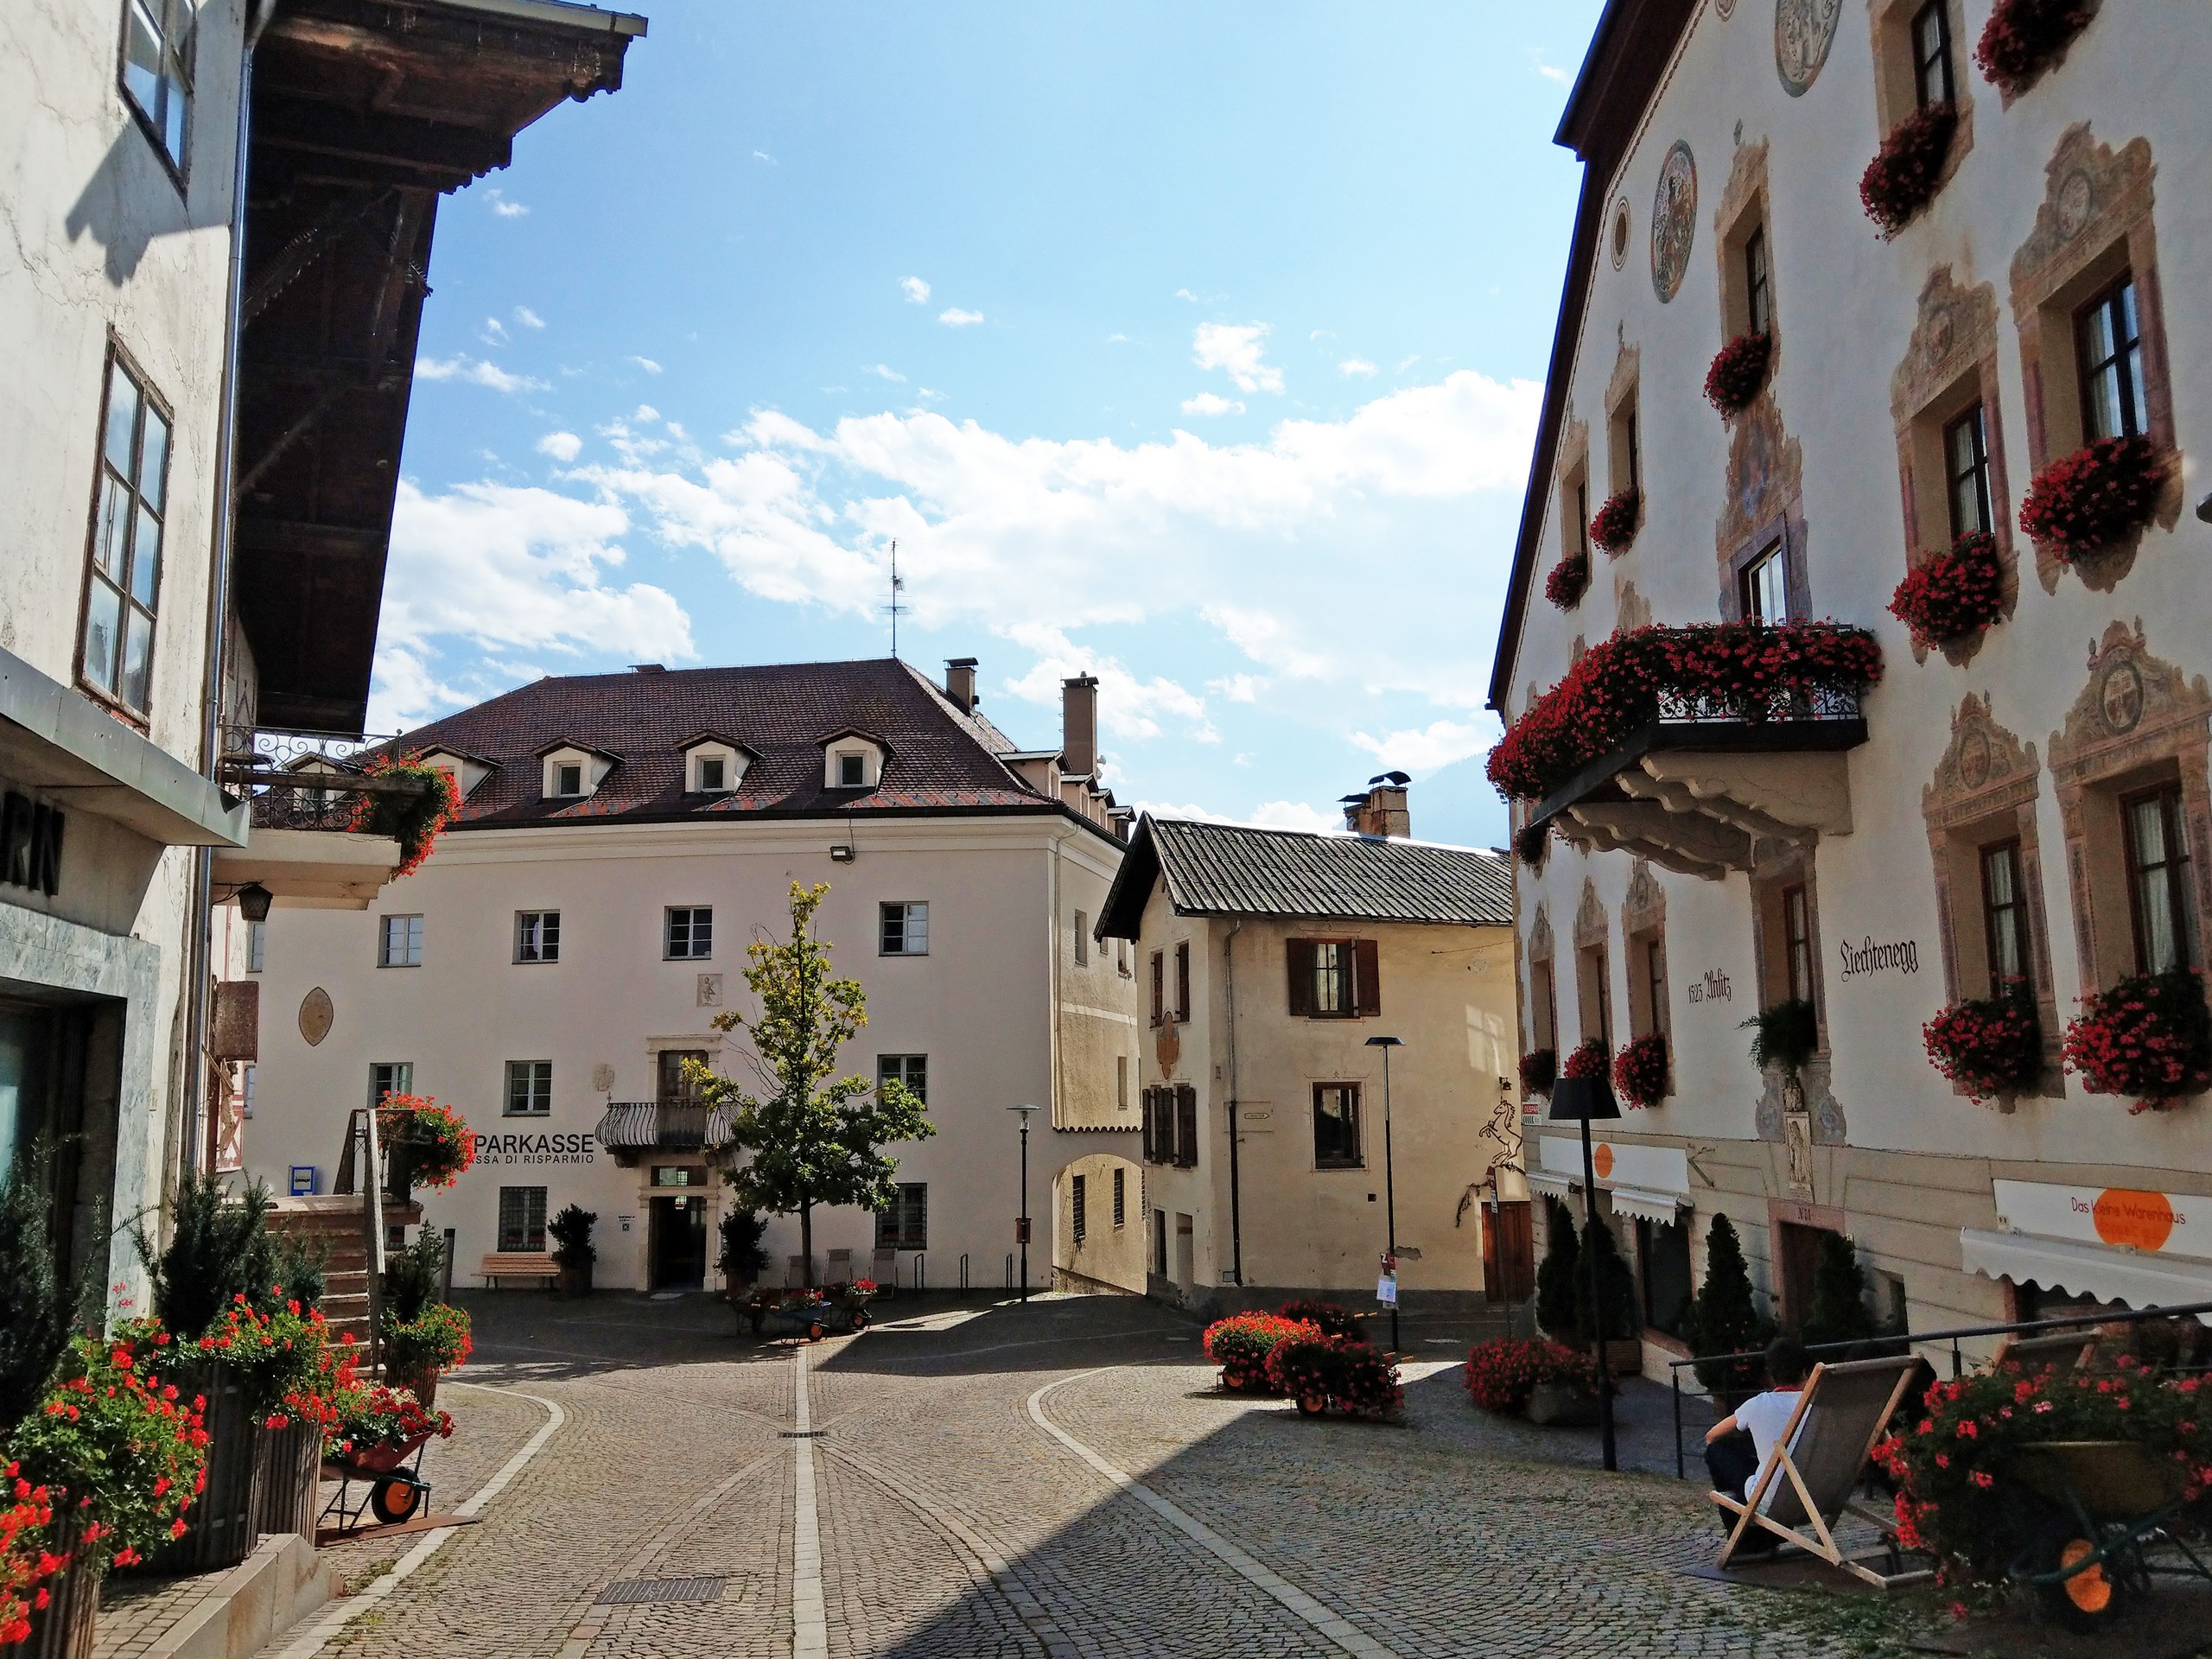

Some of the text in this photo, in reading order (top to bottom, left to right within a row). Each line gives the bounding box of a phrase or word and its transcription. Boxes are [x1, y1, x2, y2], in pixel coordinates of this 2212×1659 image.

[1840, 935, 1919, 982] Liechtenegg
[505, 1154, 518, 1164] DI
[524, 1154, 594, 1164] RISPARMIO
[2071, 1197, 2186, 1225] Das kleine Warenhaus
